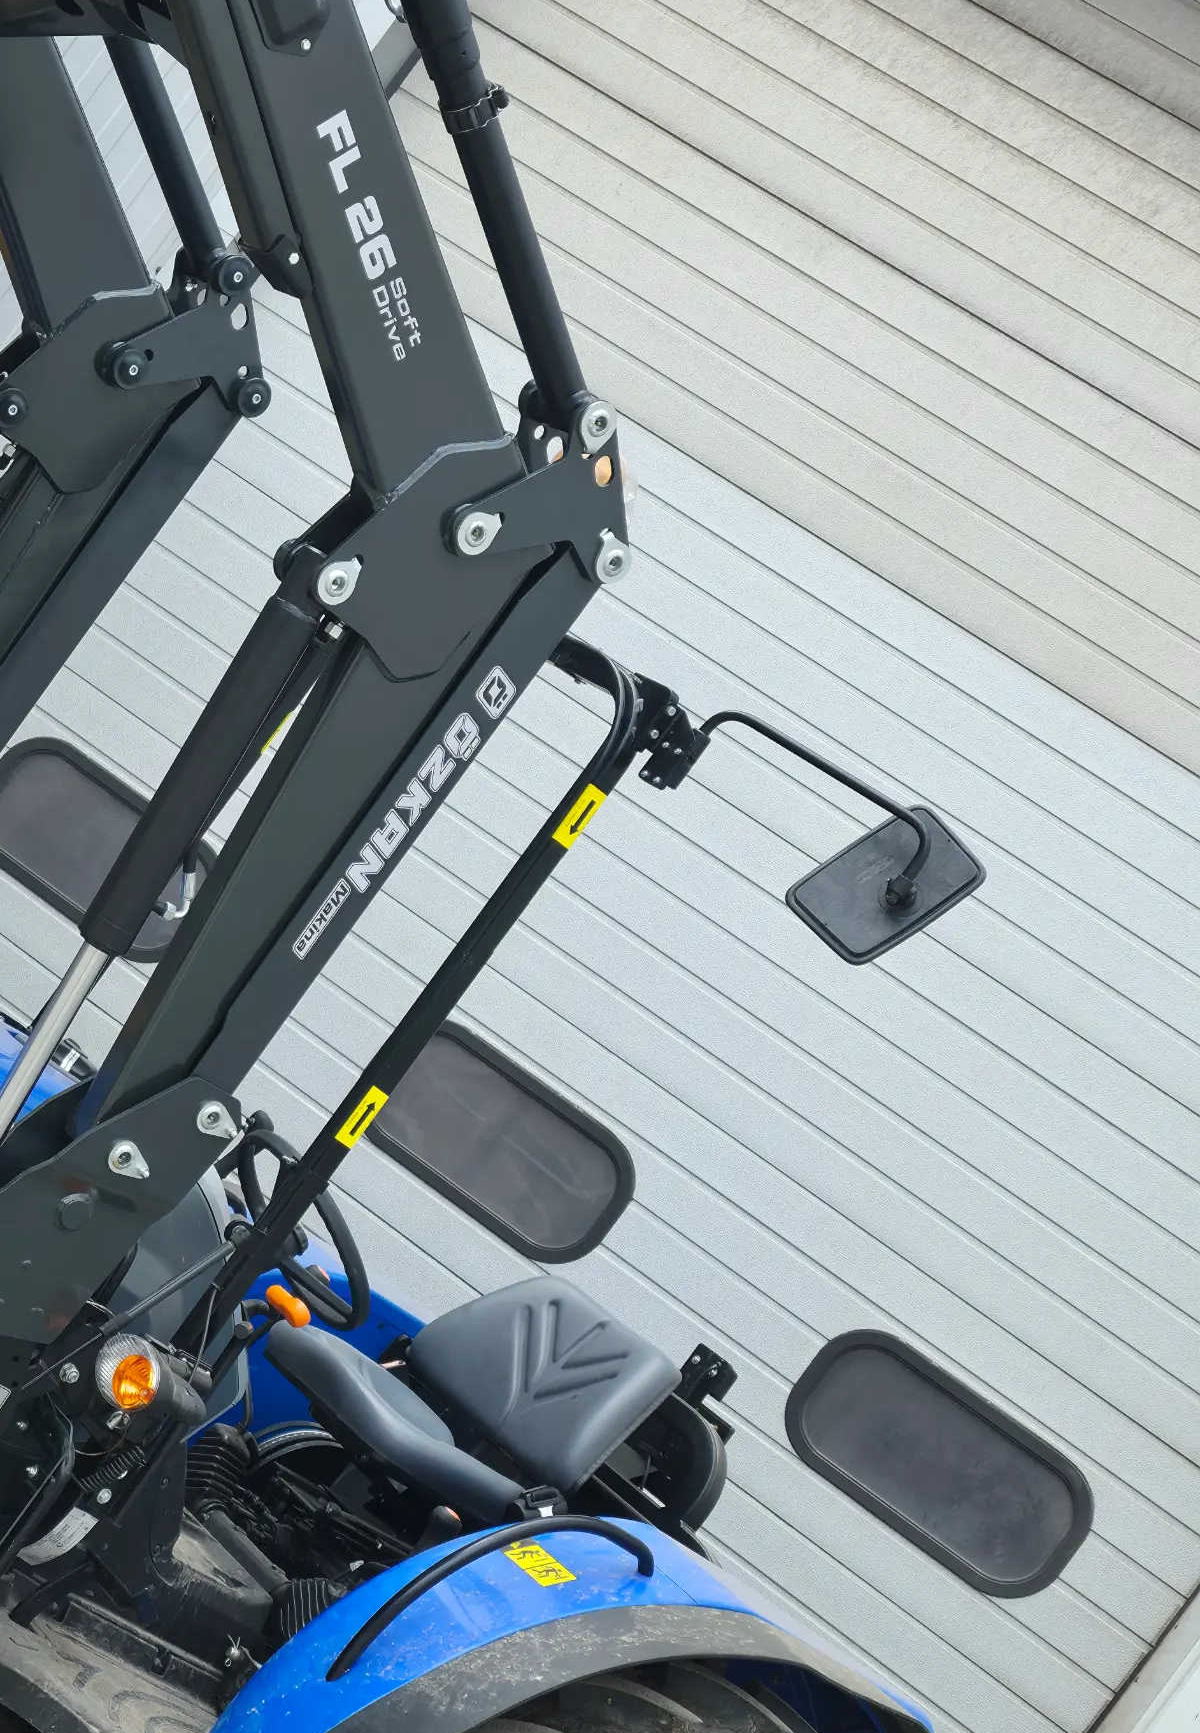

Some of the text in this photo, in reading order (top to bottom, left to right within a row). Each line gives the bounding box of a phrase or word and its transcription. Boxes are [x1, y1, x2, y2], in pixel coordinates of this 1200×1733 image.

[316, 109, 398, 281] FL 26
[372, 284, 407, 362] Drive
[389, 276, 422, 348] Soft
[346, 712, 482, 894] ÖZKAN
[294, 881, 351, 956] Makina
